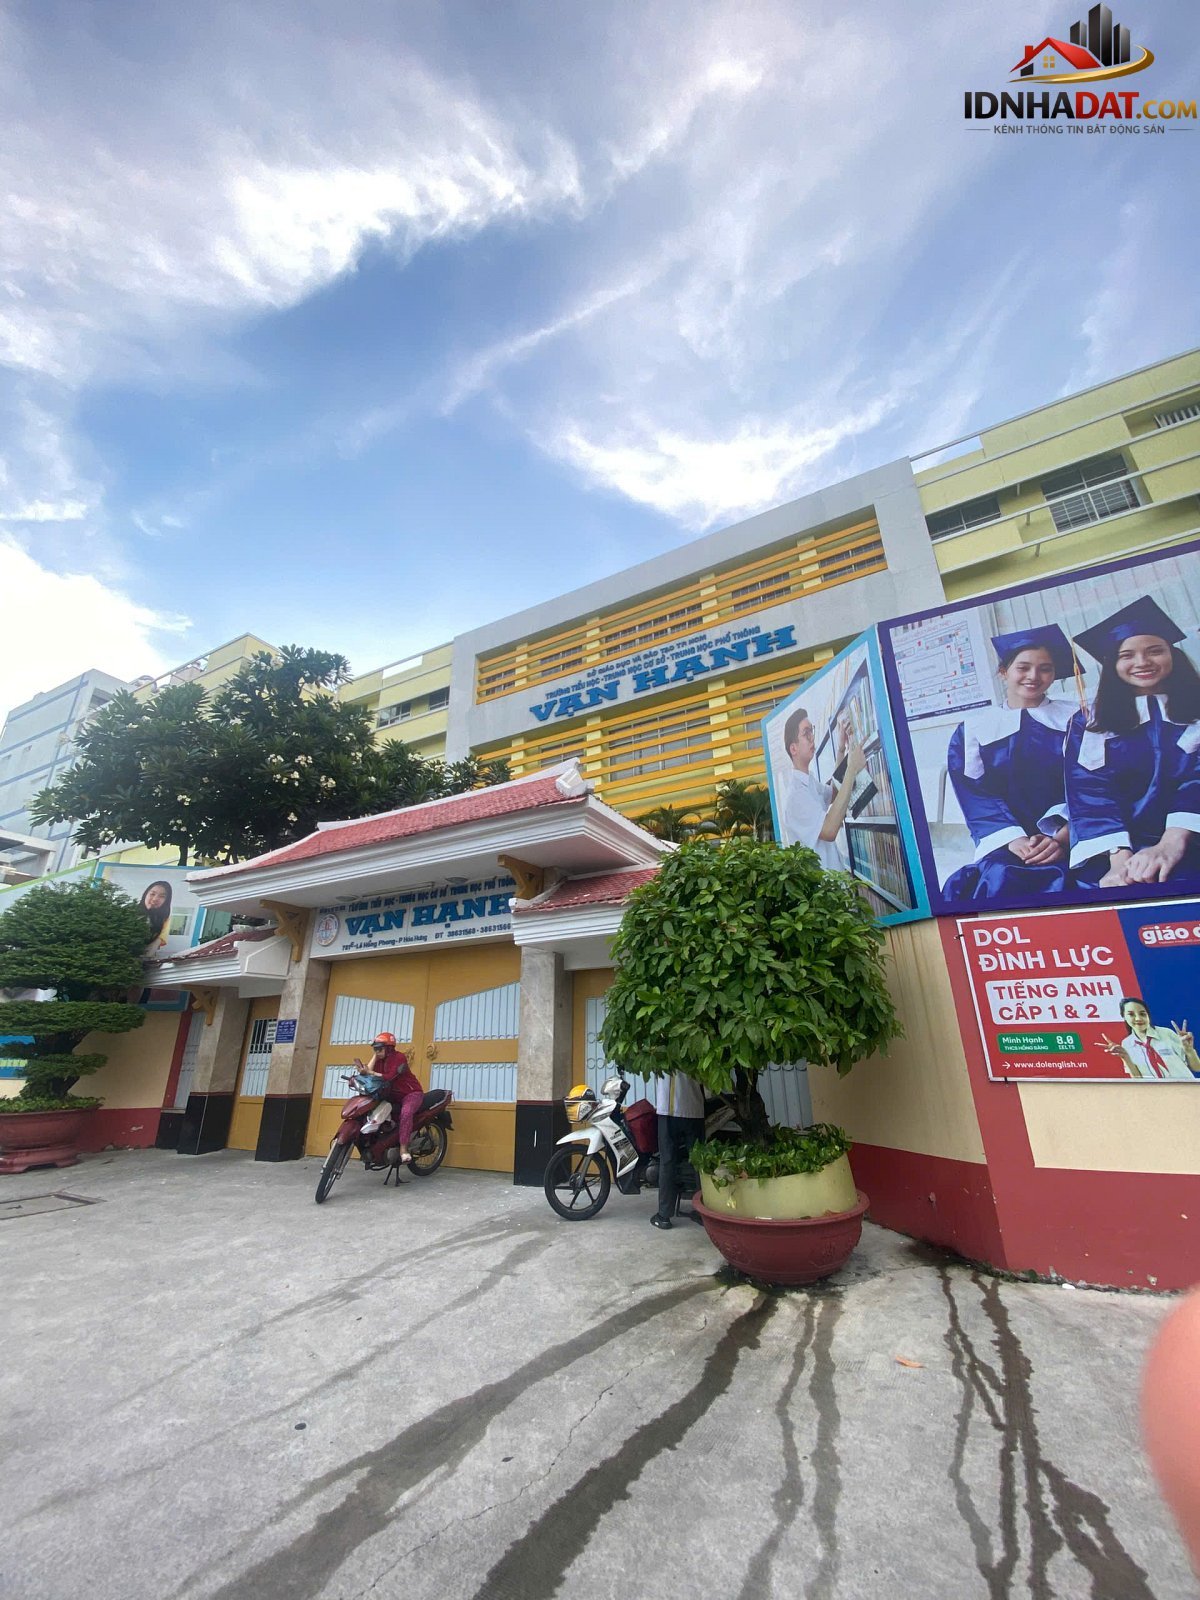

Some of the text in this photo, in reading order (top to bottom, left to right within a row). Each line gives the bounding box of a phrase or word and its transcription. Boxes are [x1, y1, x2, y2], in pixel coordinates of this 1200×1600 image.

[586, 676, 601, 688] HỌC
[603, 668, 627, 682] TRUNG
[627, 663, 643, 675] HỌC
[643, 660, 655, 669] CƠ
[656, 653, 667, 666] SỞ
[670, 646, 696, 661] TRUNG
[696, 640, 714, 654] HỌC
[714, 630, 732, 647] PHỔ
[732, 624, 761, 642] THÔNG
[529, 624, 797, 723] VẠN HẠNH
[345, 909, 406, 938] VẠN
[411, 892, 515, 928] HẠNH
[973, 926, 1031, 947] DOL
[1141, 925, 1190, 945] giáo
[978, 944, 1114, 972] ĐÌNH LỰC
[993, 980, 1114, 1000] TIẾNG ANH
[998, 1002, 1100, 1021] CẤP 1 & 2
[1002, 1035, 1074, 1045] Minh Hạnh 8.0
[1014, 1060, 1088, 1070] www.dolenglish.vn
